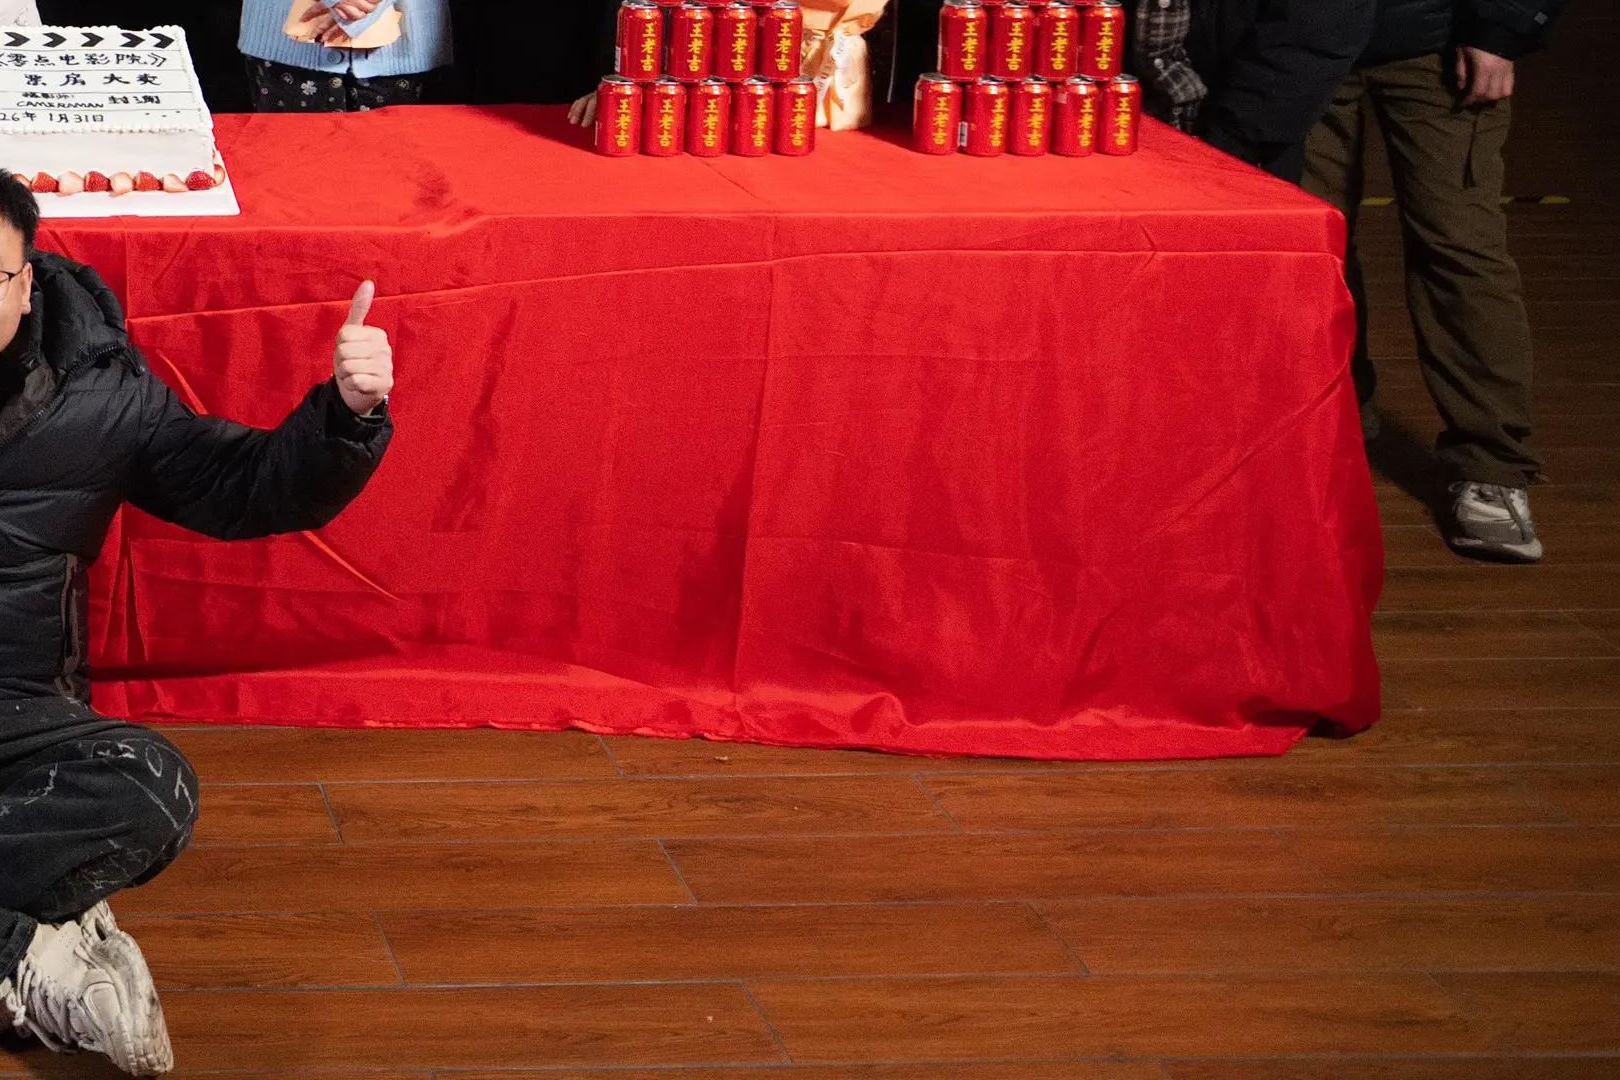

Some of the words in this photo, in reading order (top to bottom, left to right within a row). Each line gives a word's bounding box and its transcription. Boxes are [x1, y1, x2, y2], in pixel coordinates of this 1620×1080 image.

[640, 22, 656, 72] 王老吉
[687, 22, 704, 72] 王老吉
[731, 21, 748, 71] 王老吉
[775, 21, 792, 71] 王老吉
[961, 21, 978, 71] 王老吉
[1006, 21, 1024, 71] 王老吉
[1051, 21, 1069, 71] 王老吉
[1096, 20, 1114, 70] 王老吉
[16, 100, 105, 109] CAMERAMAN
[24, 72, 162, 87] 票房大卖
[49, 113, 105, 123] 1月31日
[615, 97, 631, 147] 王老吉
[658, 97, 674, 147] 王老吉
[703, 97, 719, 147] 王老吉
[752, 97, 767, 147] 王老吉
[791, 97, 807, 147] 王老吉
[933, 95, 949, 145] 王老吉
[989, 97, 1004, 147] 王老吉
[1028, 97, 1043, 147] 王老吉
[1079, 97, 1093, 147] 王老吉
[1114, 96, 1131, 146] 王老吉
